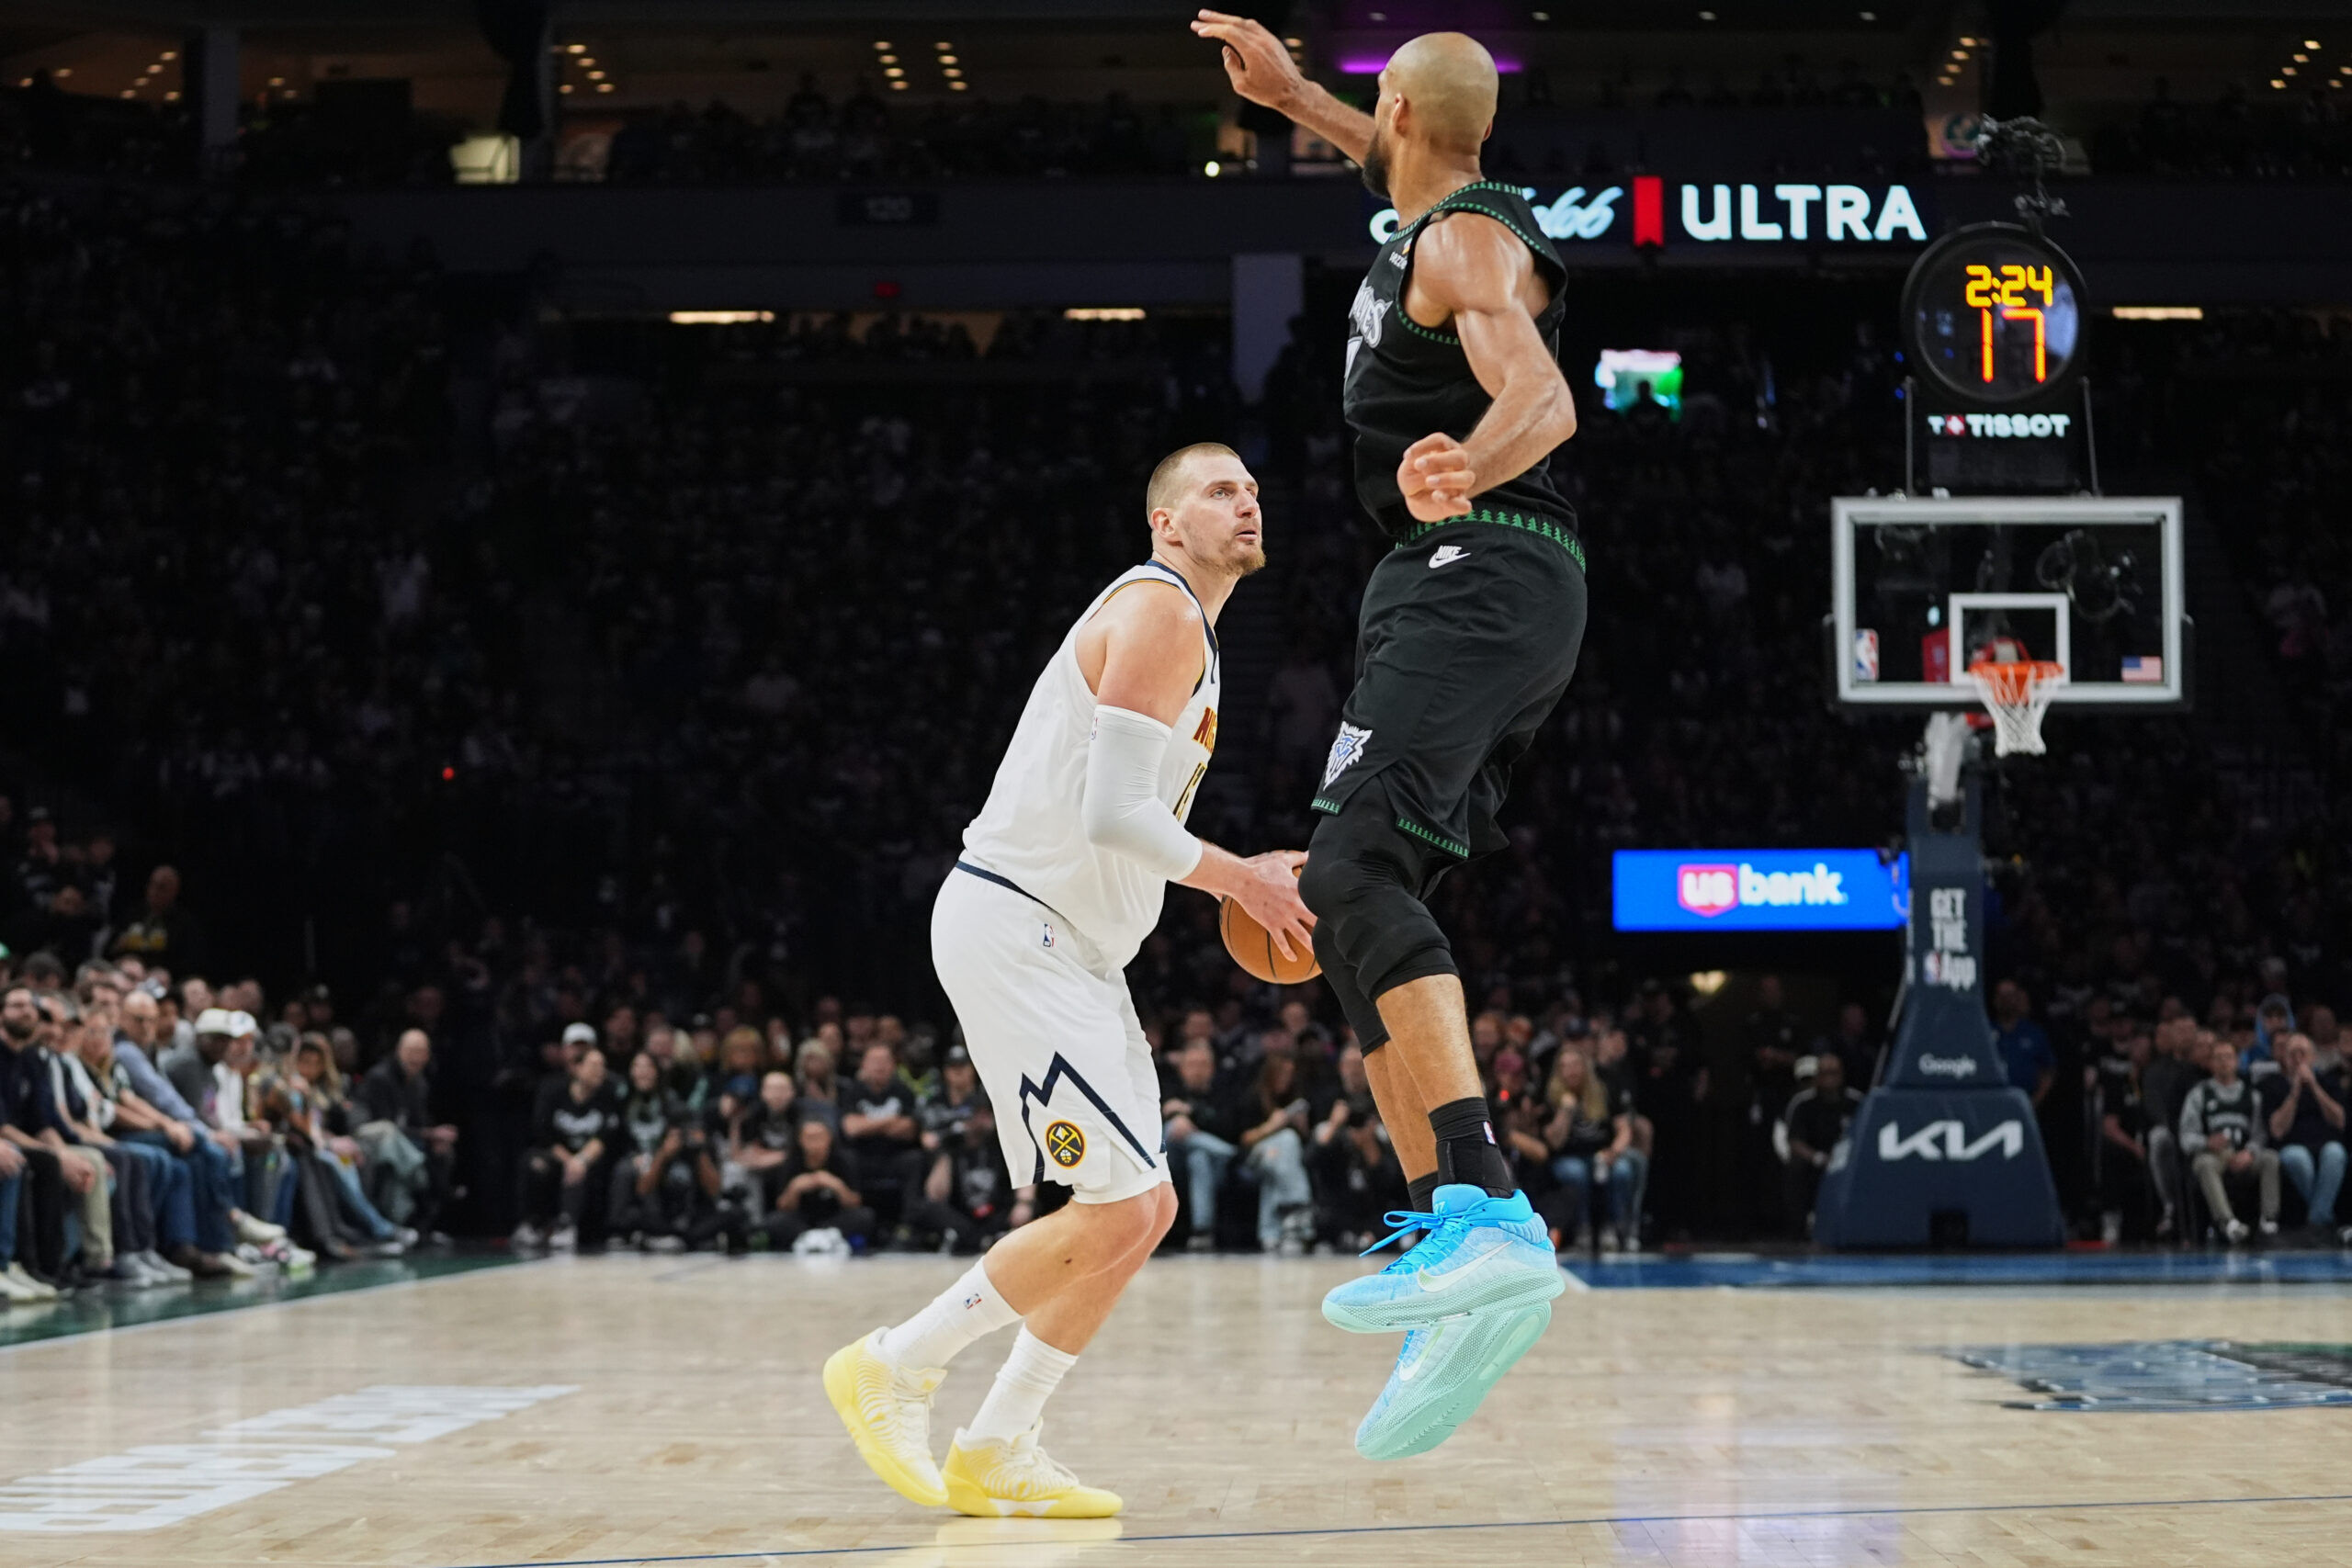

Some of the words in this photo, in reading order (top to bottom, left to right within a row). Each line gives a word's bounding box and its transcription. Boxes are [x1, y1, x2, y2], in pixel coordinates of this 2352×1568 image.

[1681, 184, 1928, 241] ULTRA
[1966, 265, 2053, 308] 2:24
[1982, 308, 2046, 383] 17
[1435, 545, 1463, 559] NIKE
[1930, 887, 1967, 919] GET
[1932, 919, 1967, 953] THE
[1918, 1054, 1977, 1078] Google
[1879, 1120, 2023, 1161] KIA
